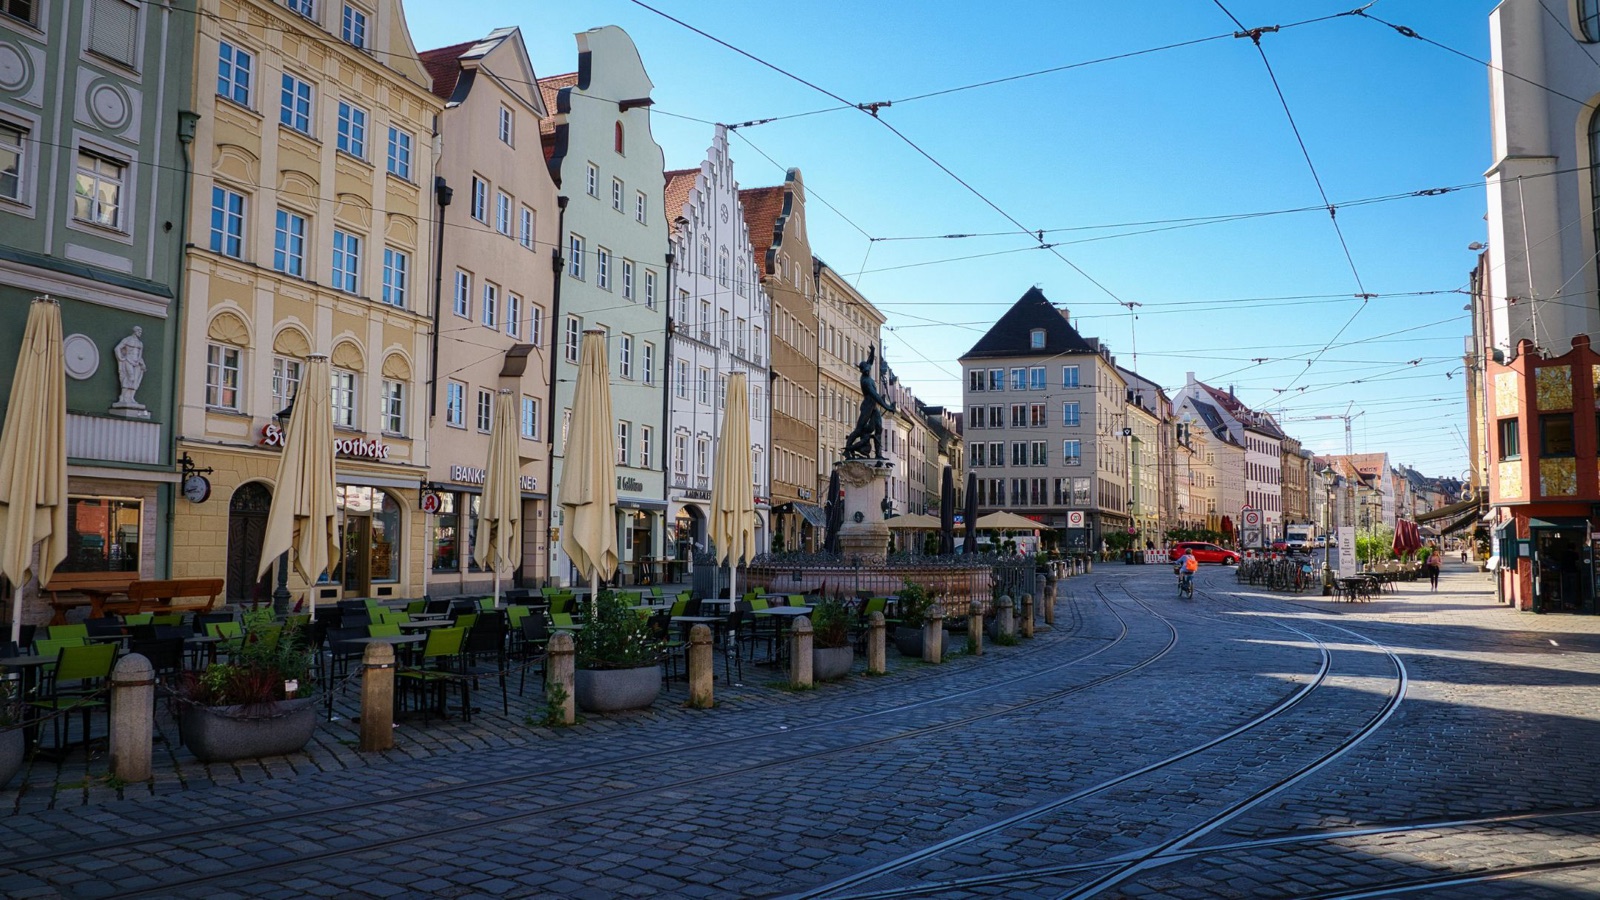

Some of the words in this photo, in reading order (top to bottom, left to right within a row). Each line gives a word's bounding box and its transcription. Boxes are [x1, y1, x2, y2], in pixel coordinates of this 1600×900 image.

[334, 437, 390, 459] potheke
[455, 466, 486, 484] BANKH
[520, 475, 538, 490] NER
